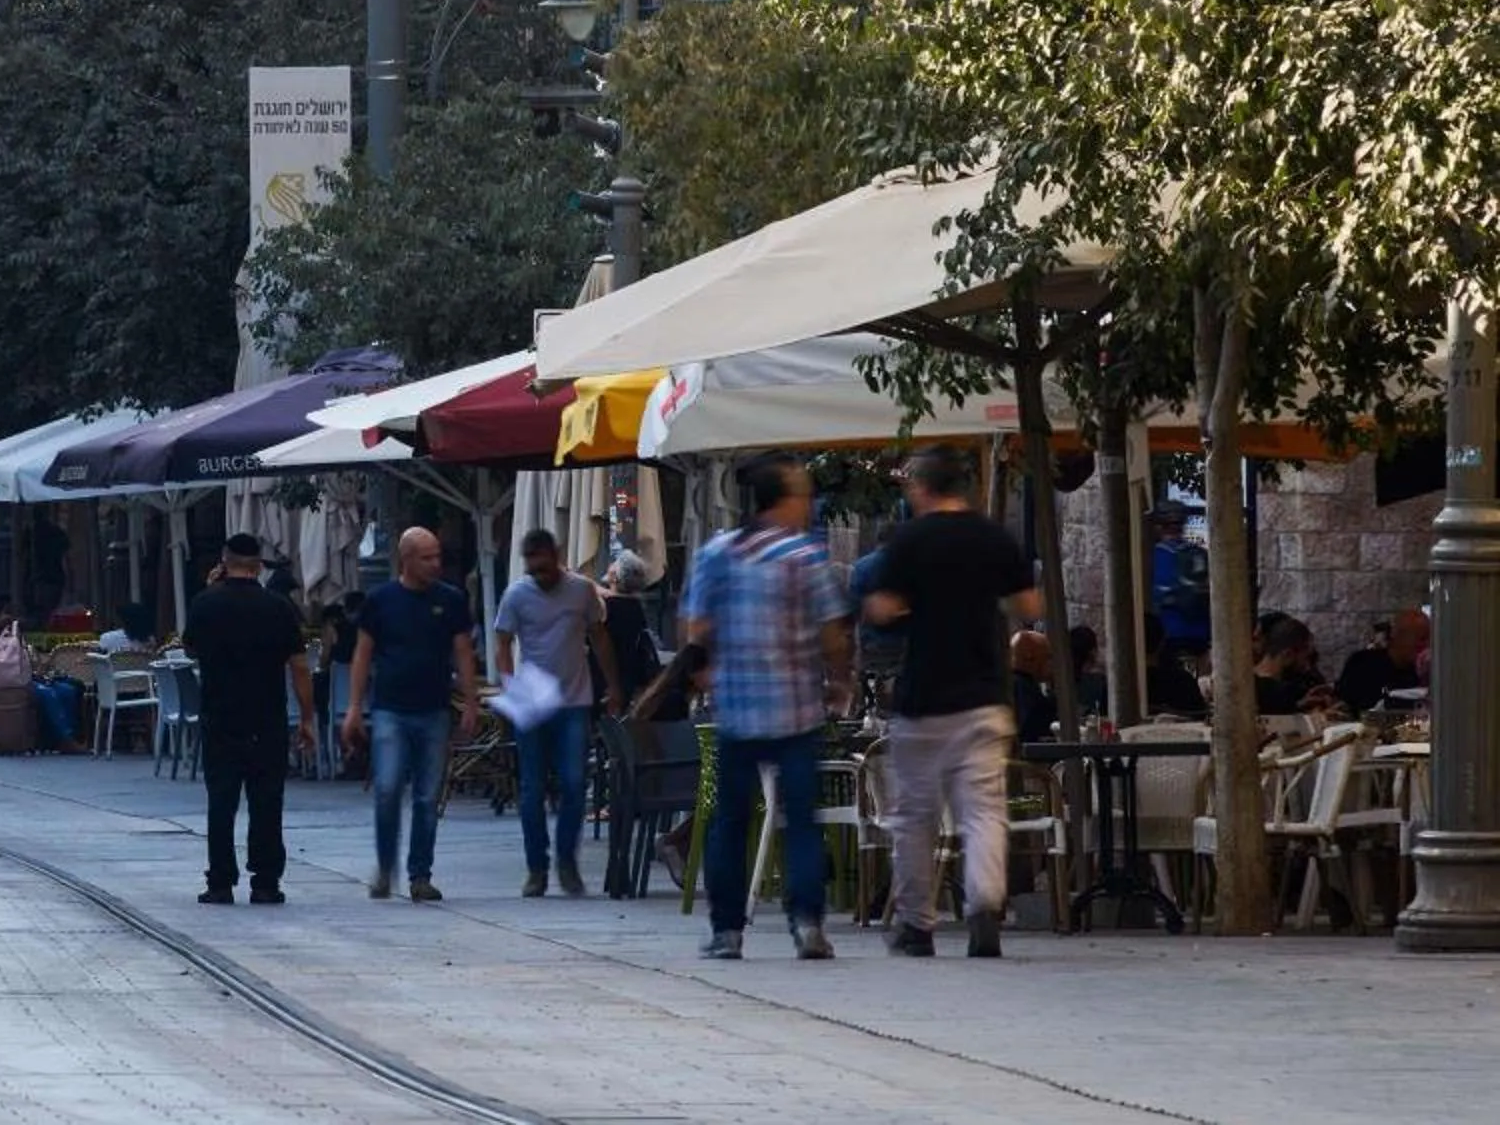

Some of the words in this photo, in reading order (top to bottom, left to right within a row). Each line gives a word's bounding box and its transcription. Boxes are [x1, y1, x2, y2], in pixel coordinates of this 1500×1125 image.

[253, 102, 292, 116] חוגגת
[295, 98, 347, 116] ירושלים
[253, 117, 301, 134] לאיחודה
[304, 121, 329, 133] שנה
[331, 121, 348, 133] 50
